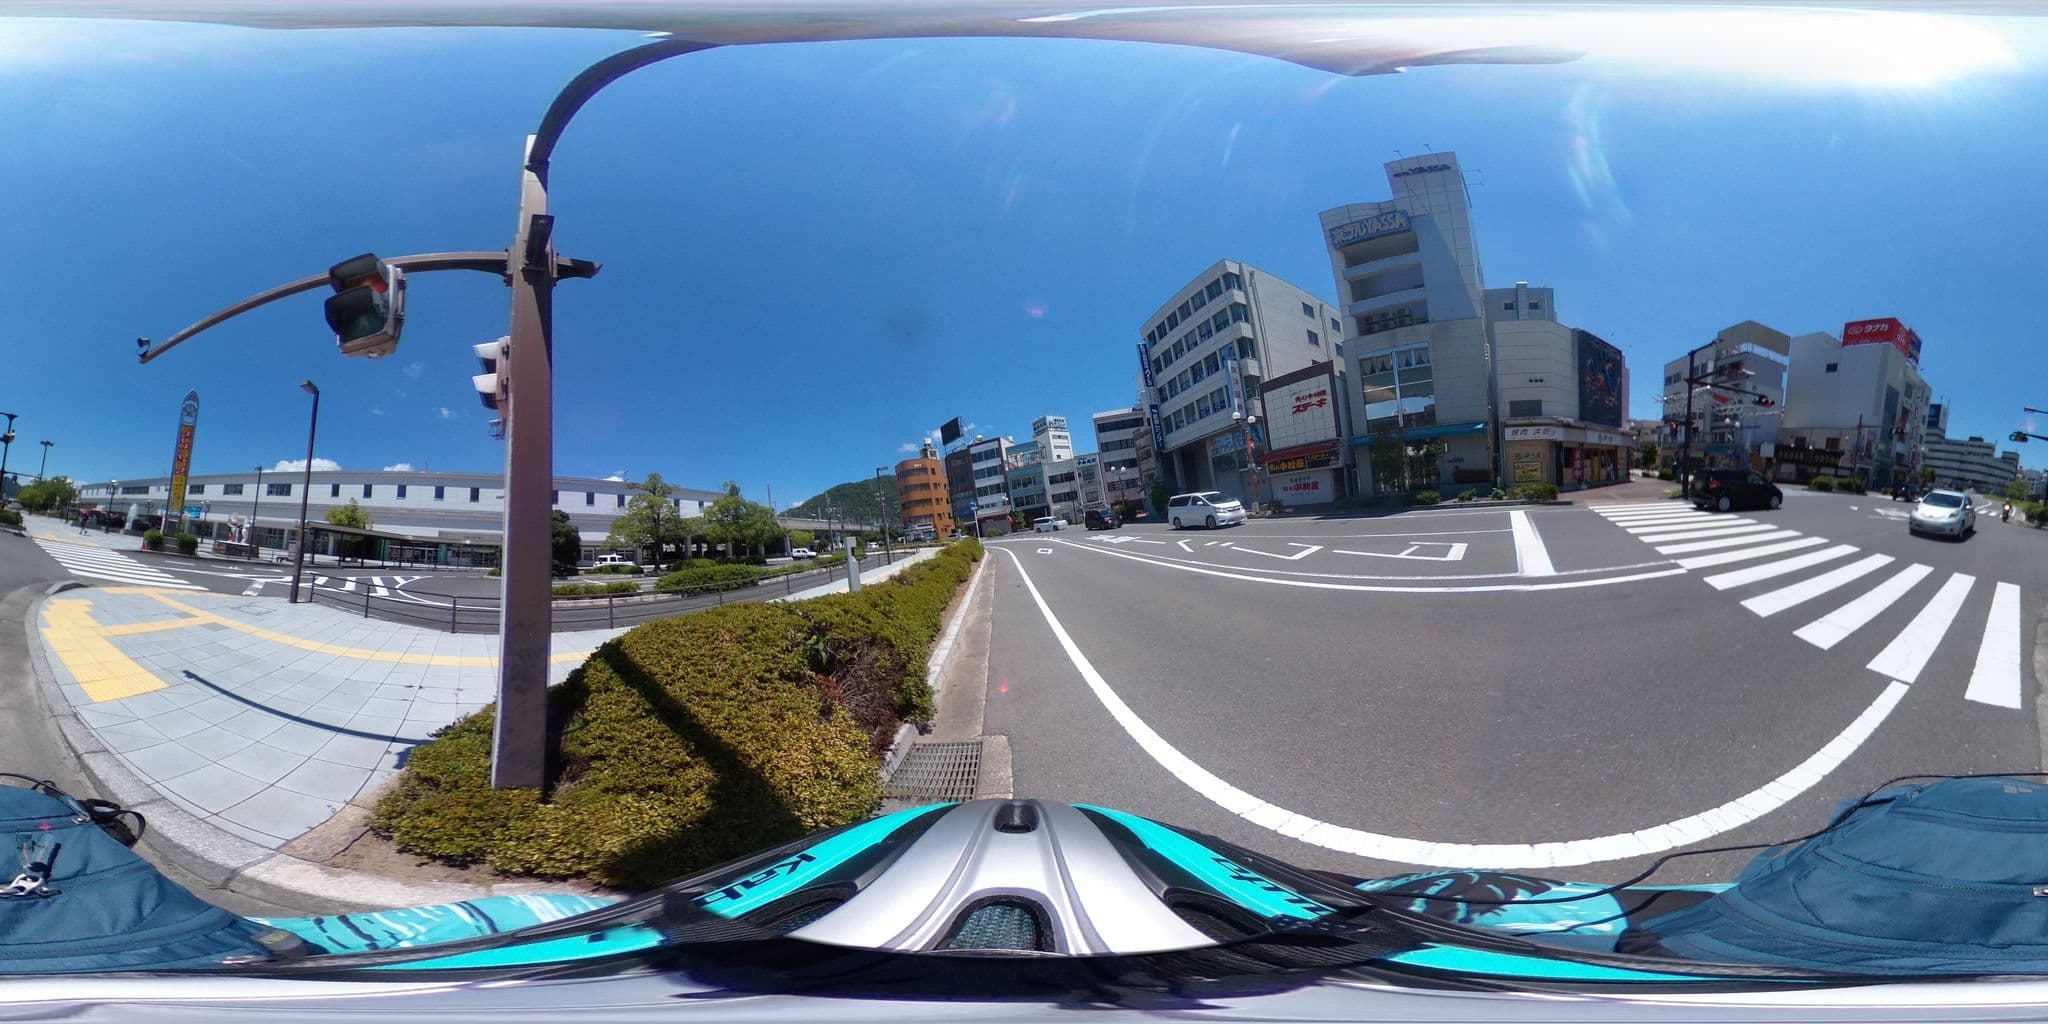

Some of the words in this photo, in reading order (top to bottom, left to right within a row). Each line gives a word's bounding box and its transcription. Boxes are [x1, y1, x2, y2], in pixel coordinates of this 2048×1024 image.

[1864, 323, 1889, 333] タナカ
[1292, 398, 1328, 415] ステーキ
